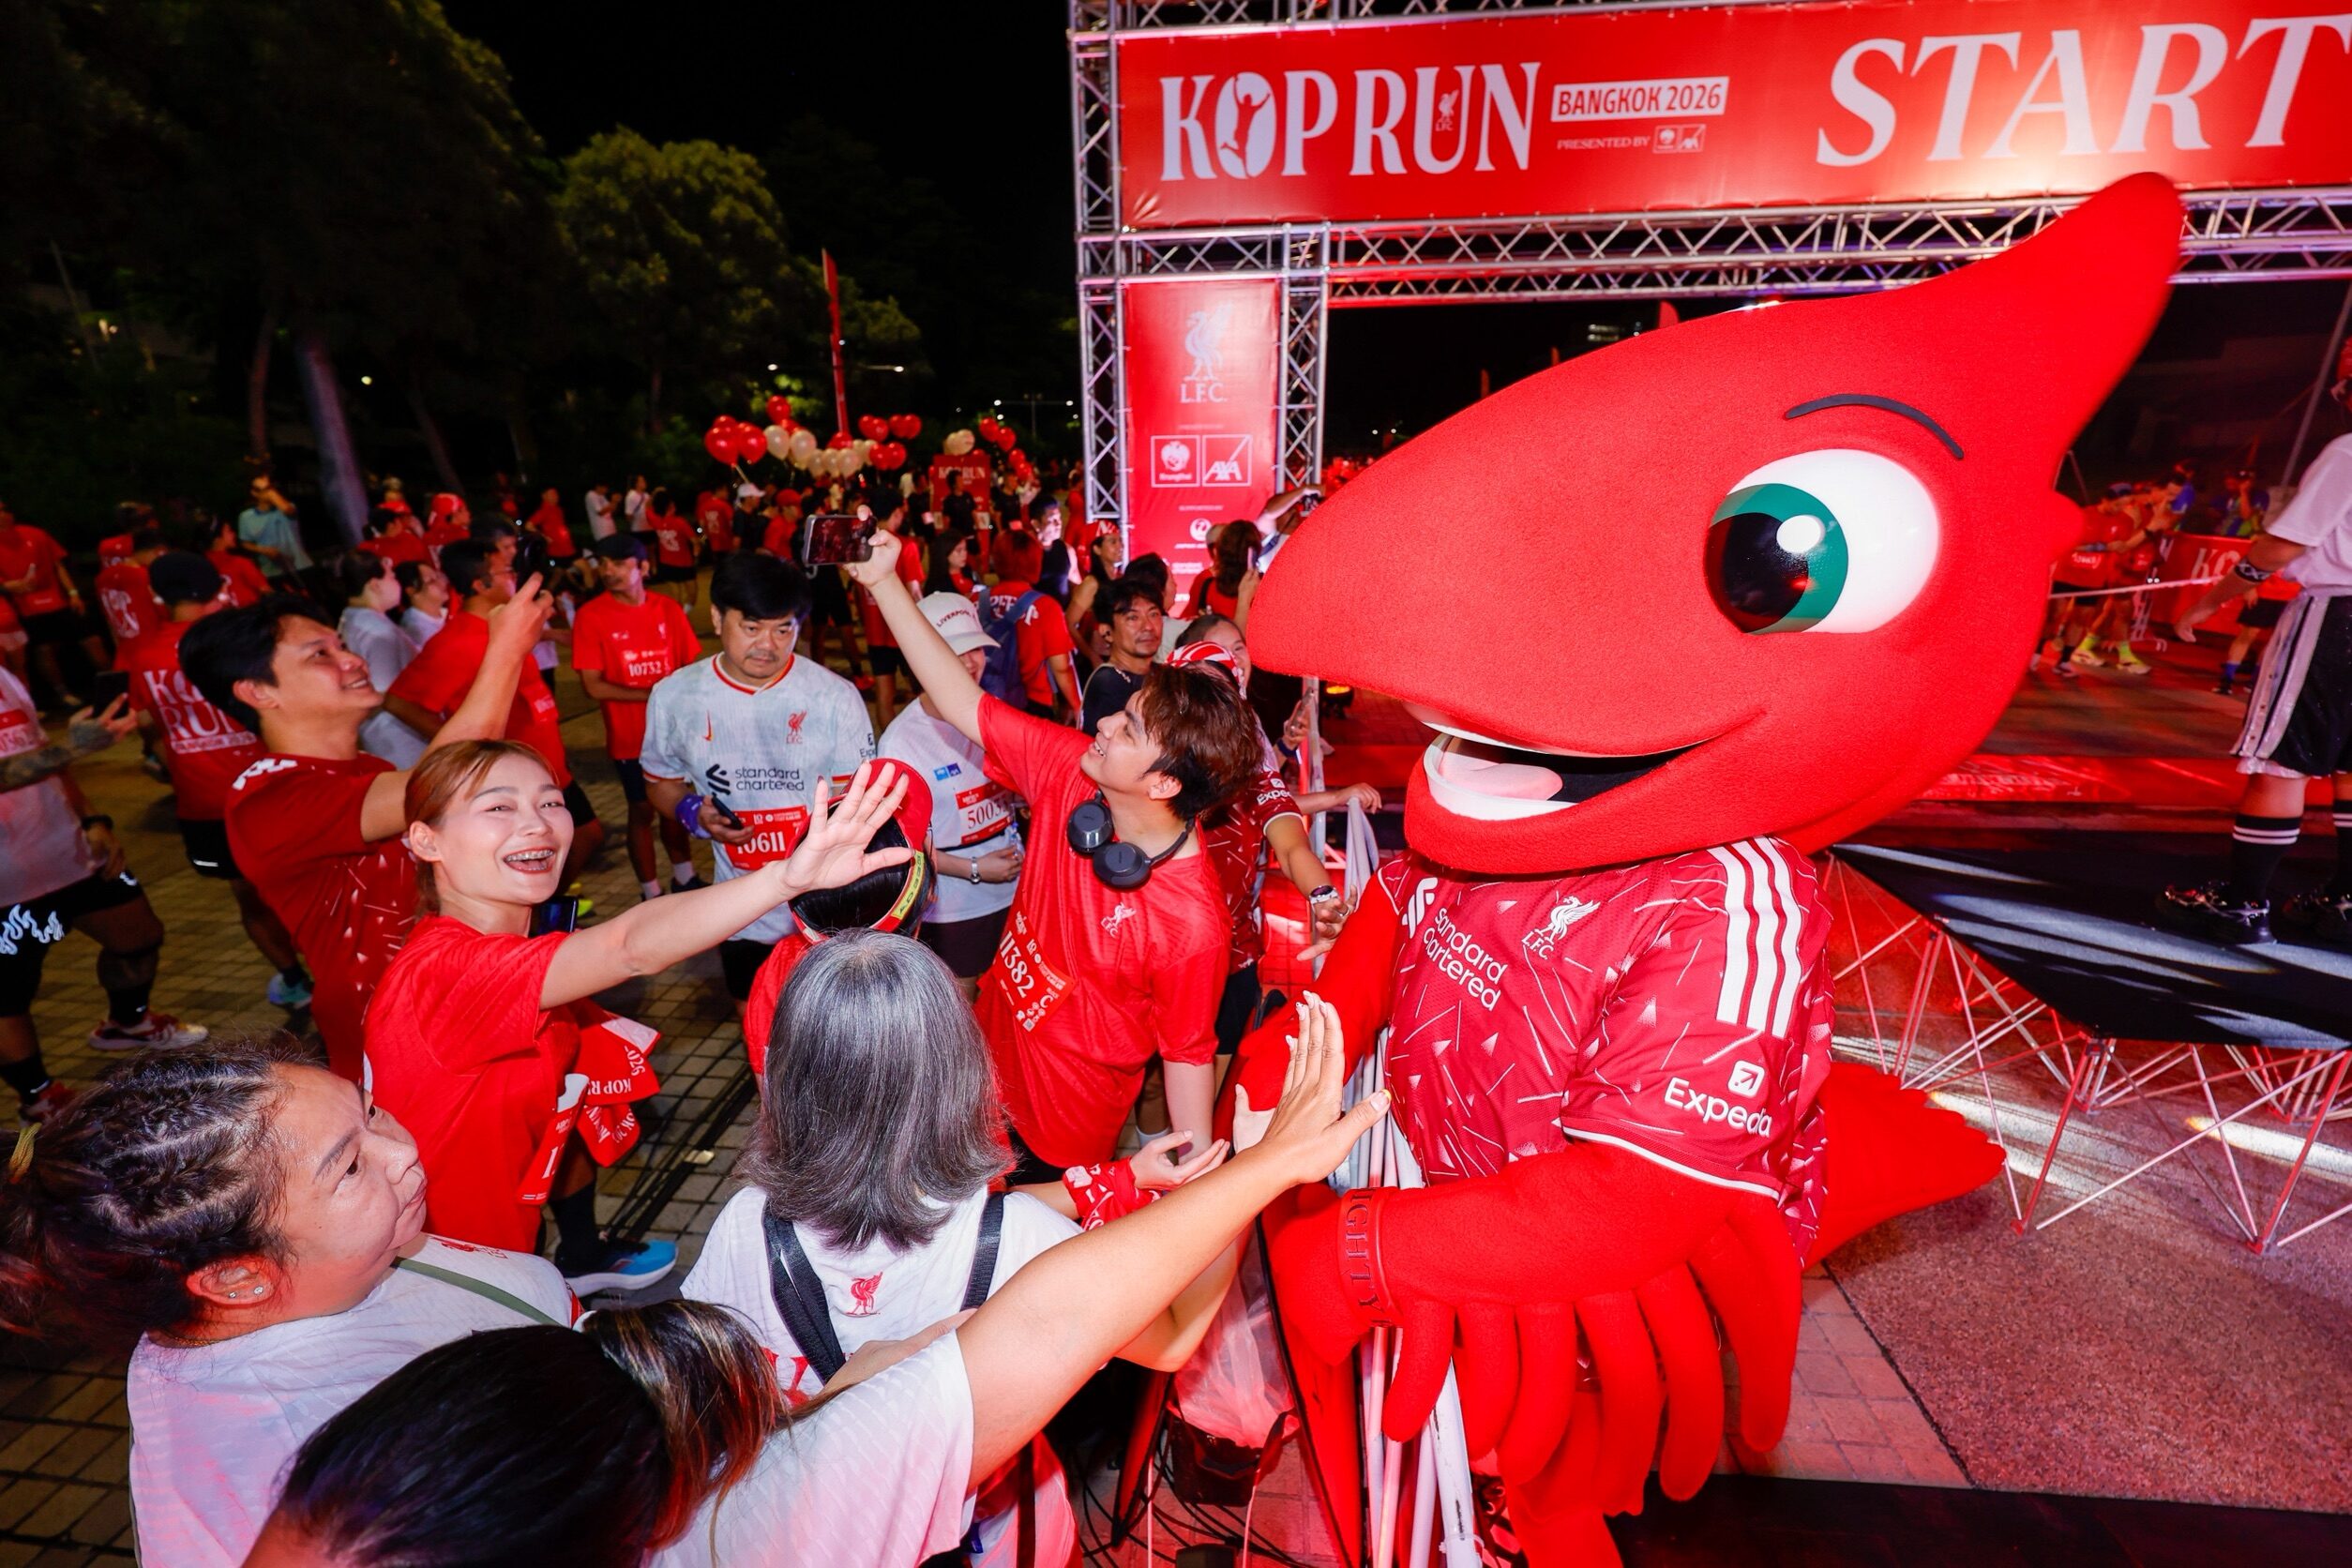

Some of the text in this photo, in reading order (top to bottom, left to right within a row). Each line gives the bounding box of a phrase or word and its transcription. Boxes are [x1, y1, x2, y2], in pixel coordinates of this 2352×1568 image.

[1558, 83, 1723, 115] BANGKOK 2026
[1817, 13, 2352, 167] START
[1159, 62, 1542, 181] KOP RUN
[1204, 460, 1243, 481] AXA
[735, 766, 800, 780] standard
[736, 778, 805, 792] chartered
[1000, 930, 1034, 999] 11382
[603, 1078, 631, 1095] KOP
